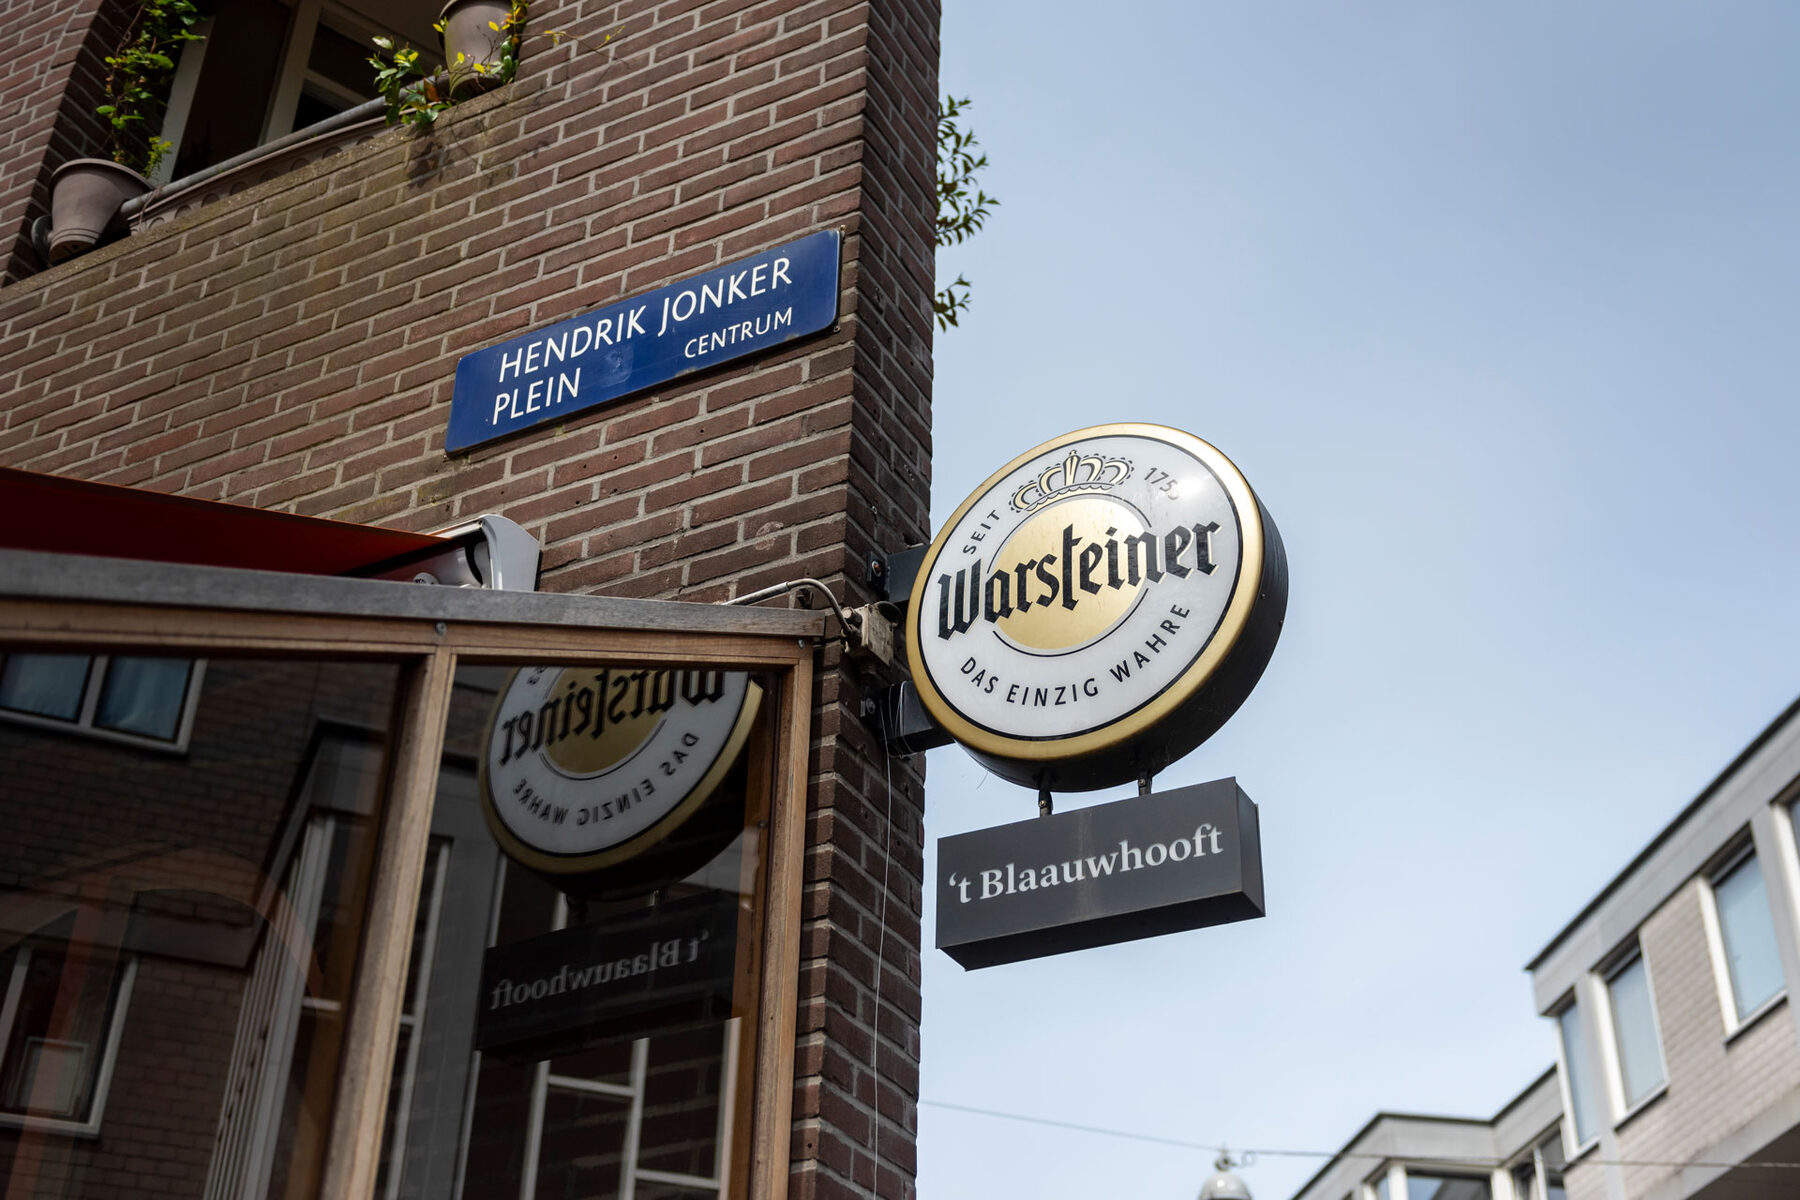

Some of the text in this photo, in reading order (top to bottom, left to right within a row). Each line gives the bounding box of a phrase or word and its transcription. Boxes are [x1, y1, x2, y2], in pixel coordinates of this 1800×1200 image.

[499, 257, 793, 383] HENDRIK JONKER
[684, 307, 792, 359] CENTRUM
[492, 368, 581, 425] PLEIN
[963, 509, 1000, 555] SEIT
[937, 520, 1222, 641] Warsteiner
[961, 604, 1190, 708] DAS EINZIG WAHRE
[979, 822, 1224, 900] Blaauwhooft
